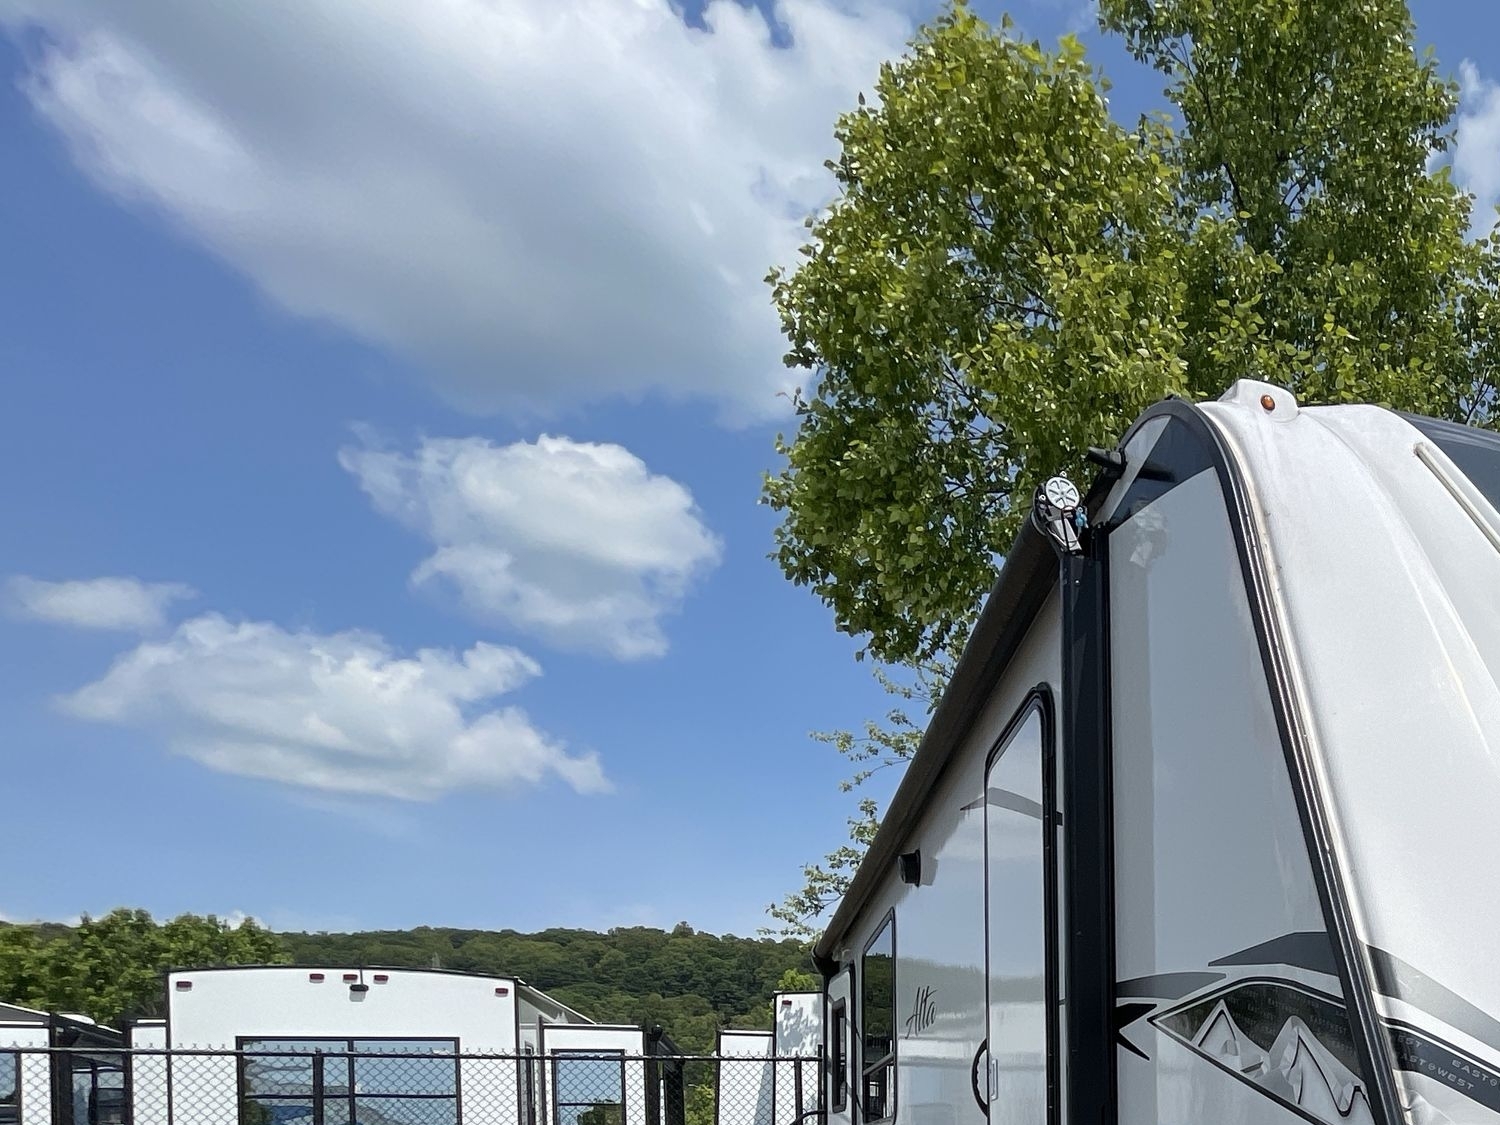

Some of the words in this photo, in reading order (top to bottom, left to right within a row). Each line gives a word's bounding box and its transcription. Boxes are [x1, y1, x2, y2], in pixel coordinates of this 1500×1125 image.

[905, 985, 938, 1039] Alta
[1437, 1066, 1475, 1090] WEST
[1452, 1059, 1488, 1080] EAST
